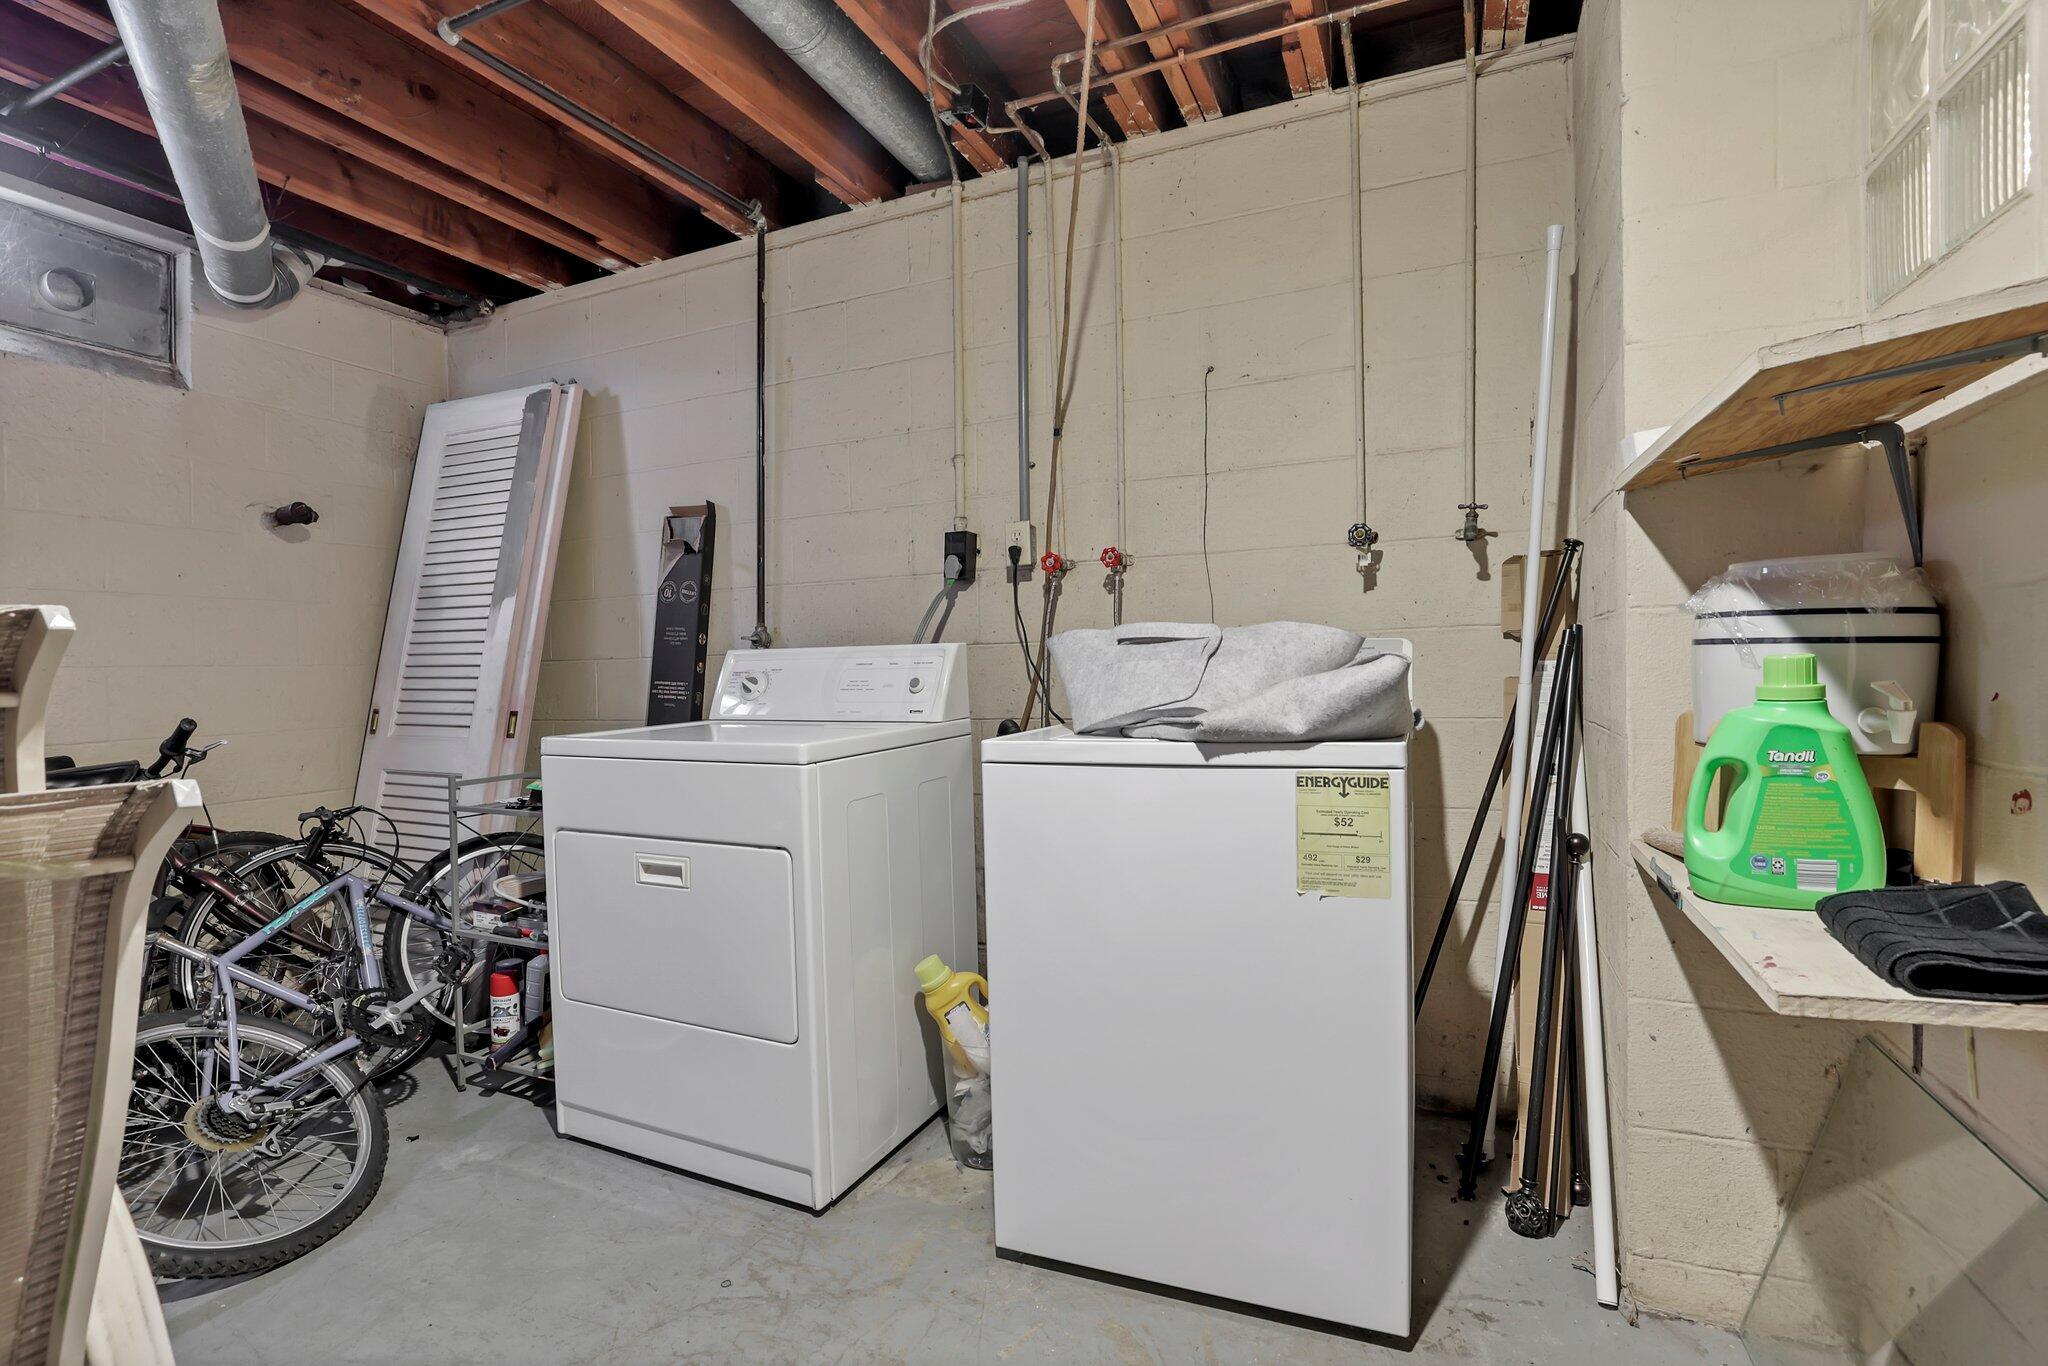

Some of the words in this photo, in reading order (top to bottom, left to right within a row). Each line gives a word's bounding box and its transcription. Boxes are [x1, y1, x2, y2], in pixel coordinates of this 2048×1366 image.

[1767, 750, 1816, 762] Tandil
[1296, 776, 1389, 789] ENERGYGUIDE
[1333, 817, 1354, 827] $52
[1302, 853, 1318, 861] 492
[1355, 855, 1371, 864] $29
